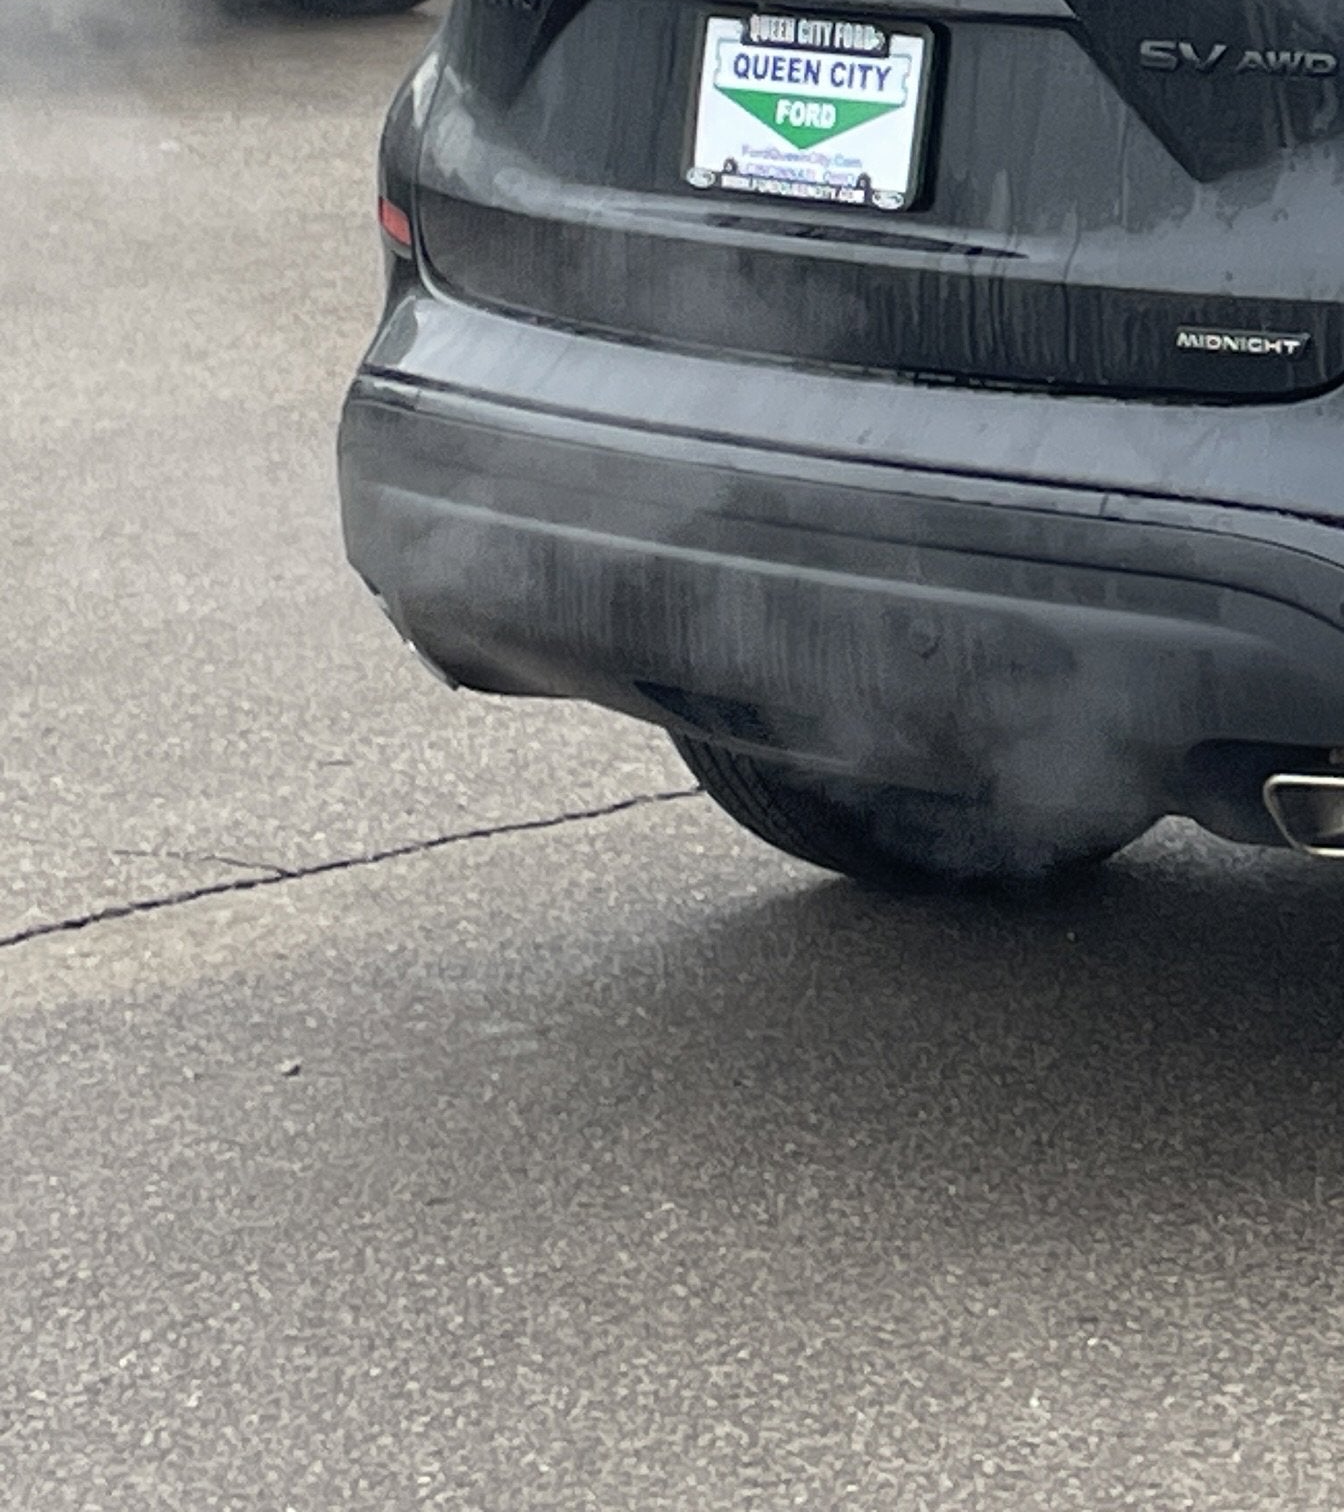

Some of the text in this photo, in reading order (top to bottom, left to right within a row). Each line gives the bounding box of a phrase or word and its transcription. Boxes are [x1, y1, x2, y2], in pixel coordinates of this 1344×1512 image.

[749, 13, 877, 51] QUEEN CITY FORD
[733, 52, 893, 92] QUEEN CITY
[1139, 40, 1338, 75] SV AWD
[775, 98, 837, 129] FORD
[1175, 331, 1301, 355] MIDNIGHT
